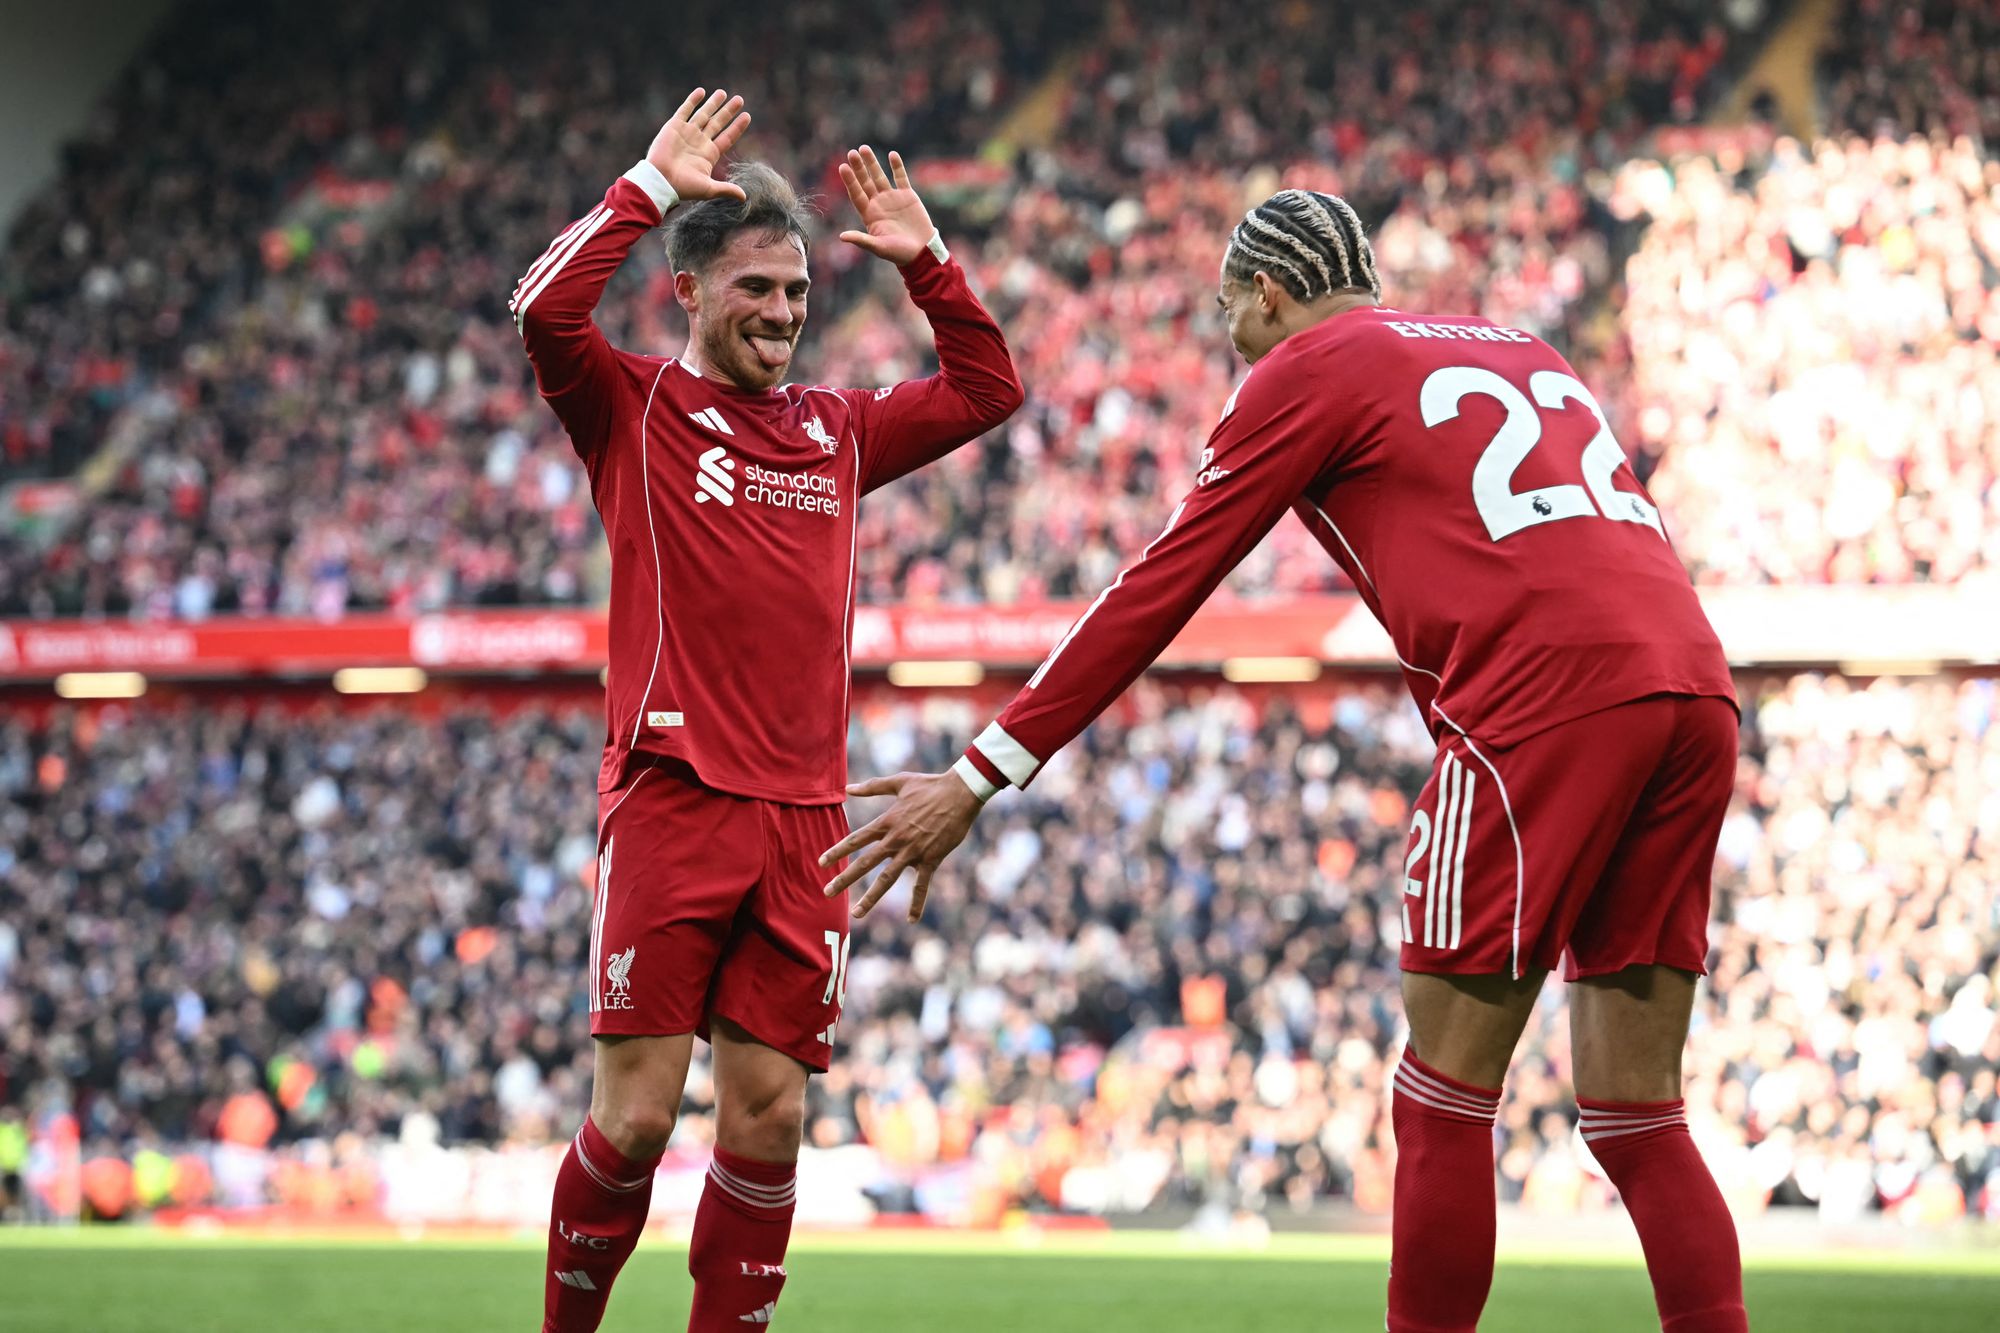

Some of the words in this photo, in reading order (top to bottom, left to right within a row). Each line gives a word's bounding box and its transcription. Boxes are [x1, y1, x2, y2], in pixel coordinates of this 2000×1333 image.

[1420, 366, 1668, 542] 22
[745, 464, 836, 496] standard
[745, 483, 840, 517] chartered
[559, 1220, 608, 1249] LFC
